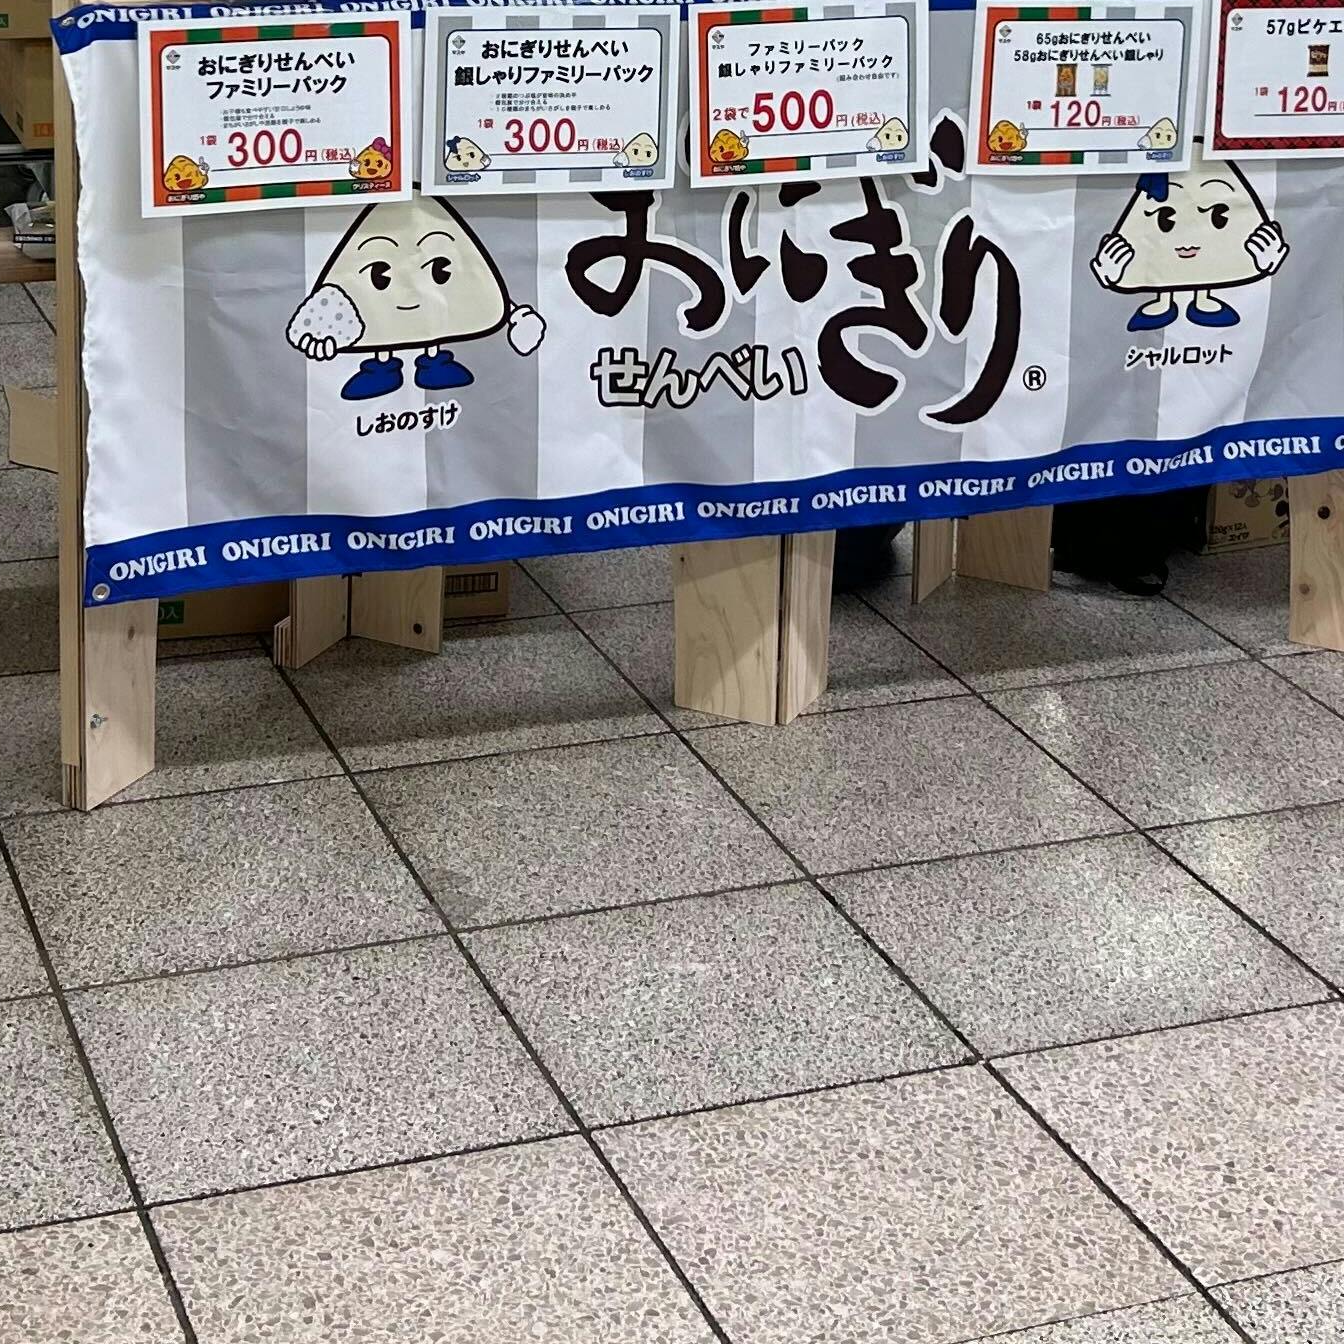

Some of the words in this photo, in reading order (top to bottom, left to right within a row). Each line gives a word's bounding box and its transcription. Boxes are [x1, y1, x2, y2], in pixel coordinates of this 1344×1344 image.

[77, 7, 193, 29] ONIGIRI
[482, 40, 629, 59] おにぎりせんべい
[748, 37, 865, 56] ファミリーパック
[1036, 31, 1152, 46] 65gおにぎりせんべい
[198, 51, 355, 77] おにぎりせんべい
[718, 54, 893, 78] 銀しゃりファミリーパック
[1014, 49, 1164, 63] 58gおにぎりせんべい銀しゃり
[206, 74, 348, 99] ファミリーパック
[454, 65, 654, 86] 銀しゃりファミリーパック
[712, 105, 749, 122] 2袋で
[564, 115, 1023, 425] おにぎり
[1126, 344, 1233, 367] シャルロット
[590, 343, 808, 409] せんべい
[356, 403, 458, 437] しおのすけ
[109, 546, 208, 581] ONIGIRI
[222, 532, 332, 562] ONIGIRI
[347, 526, 456, 551] ONIGIRI
[469, 516, 573, 541] ONIGIRI
[586, 501, 685, 531] ONIGIRI
[697, 497, 801, 519] ONIGIRI
[811, 484, 907, 510] ONIGIRI
[918, 476, 1016, 498] ONIGIRI
[1027, 459, 1115, 489] ONIGIRI
[1126, 445, 1213, 476] ONIGIRI
[1222, 436, 1321, 459] ONIGIRI
